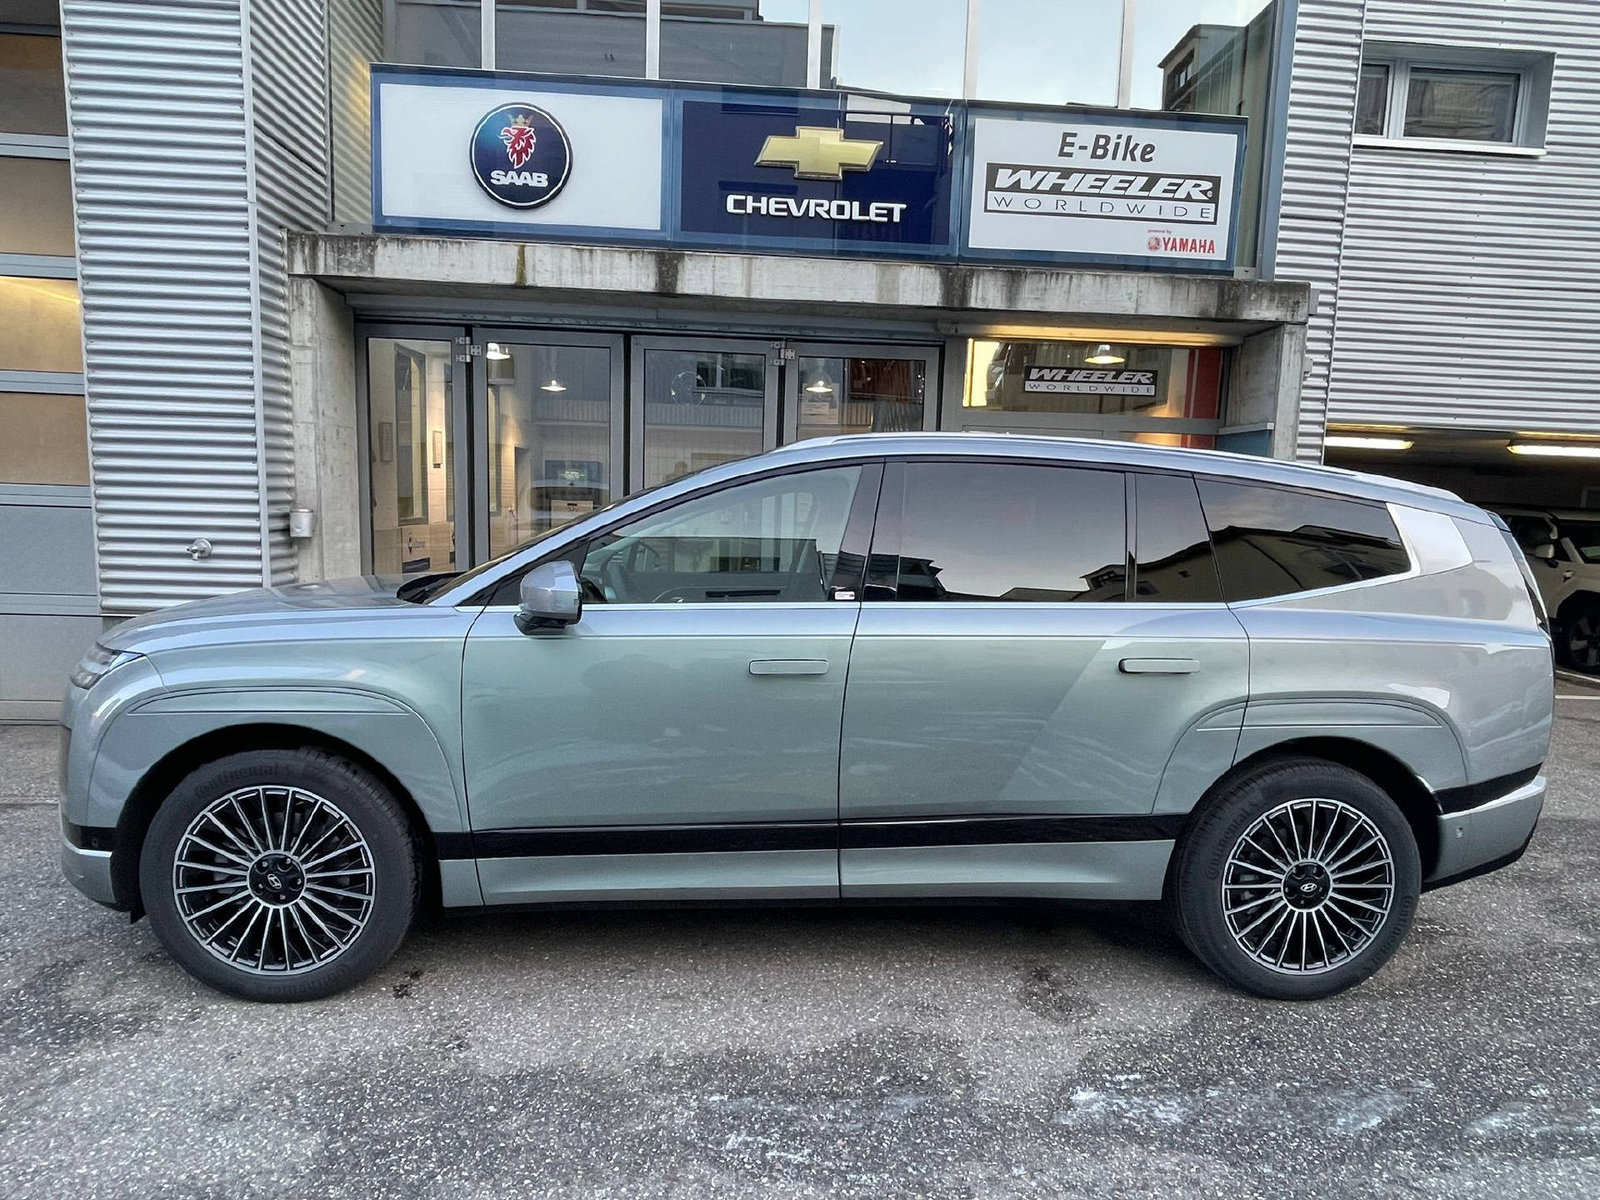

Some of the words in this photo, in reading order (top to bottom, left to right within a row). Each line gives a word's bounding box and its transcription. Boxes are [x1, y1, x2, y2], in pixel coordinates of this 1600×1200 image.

[1058, 132, 1156, 163] E-Bike
[490, 170, 549, 188] SAAB
[994, 168, 1213, 200] WHEELER
[726, 194, 907, 223] CHEVROLET
[993, 196, 1212, 219] WORLDWIDE
[1162, 236, 1215, 254] YAMAHA
[1029, 368, 1154, 384] WHEELER
[1028, 383, 1153, 394] WORLDWIDE
